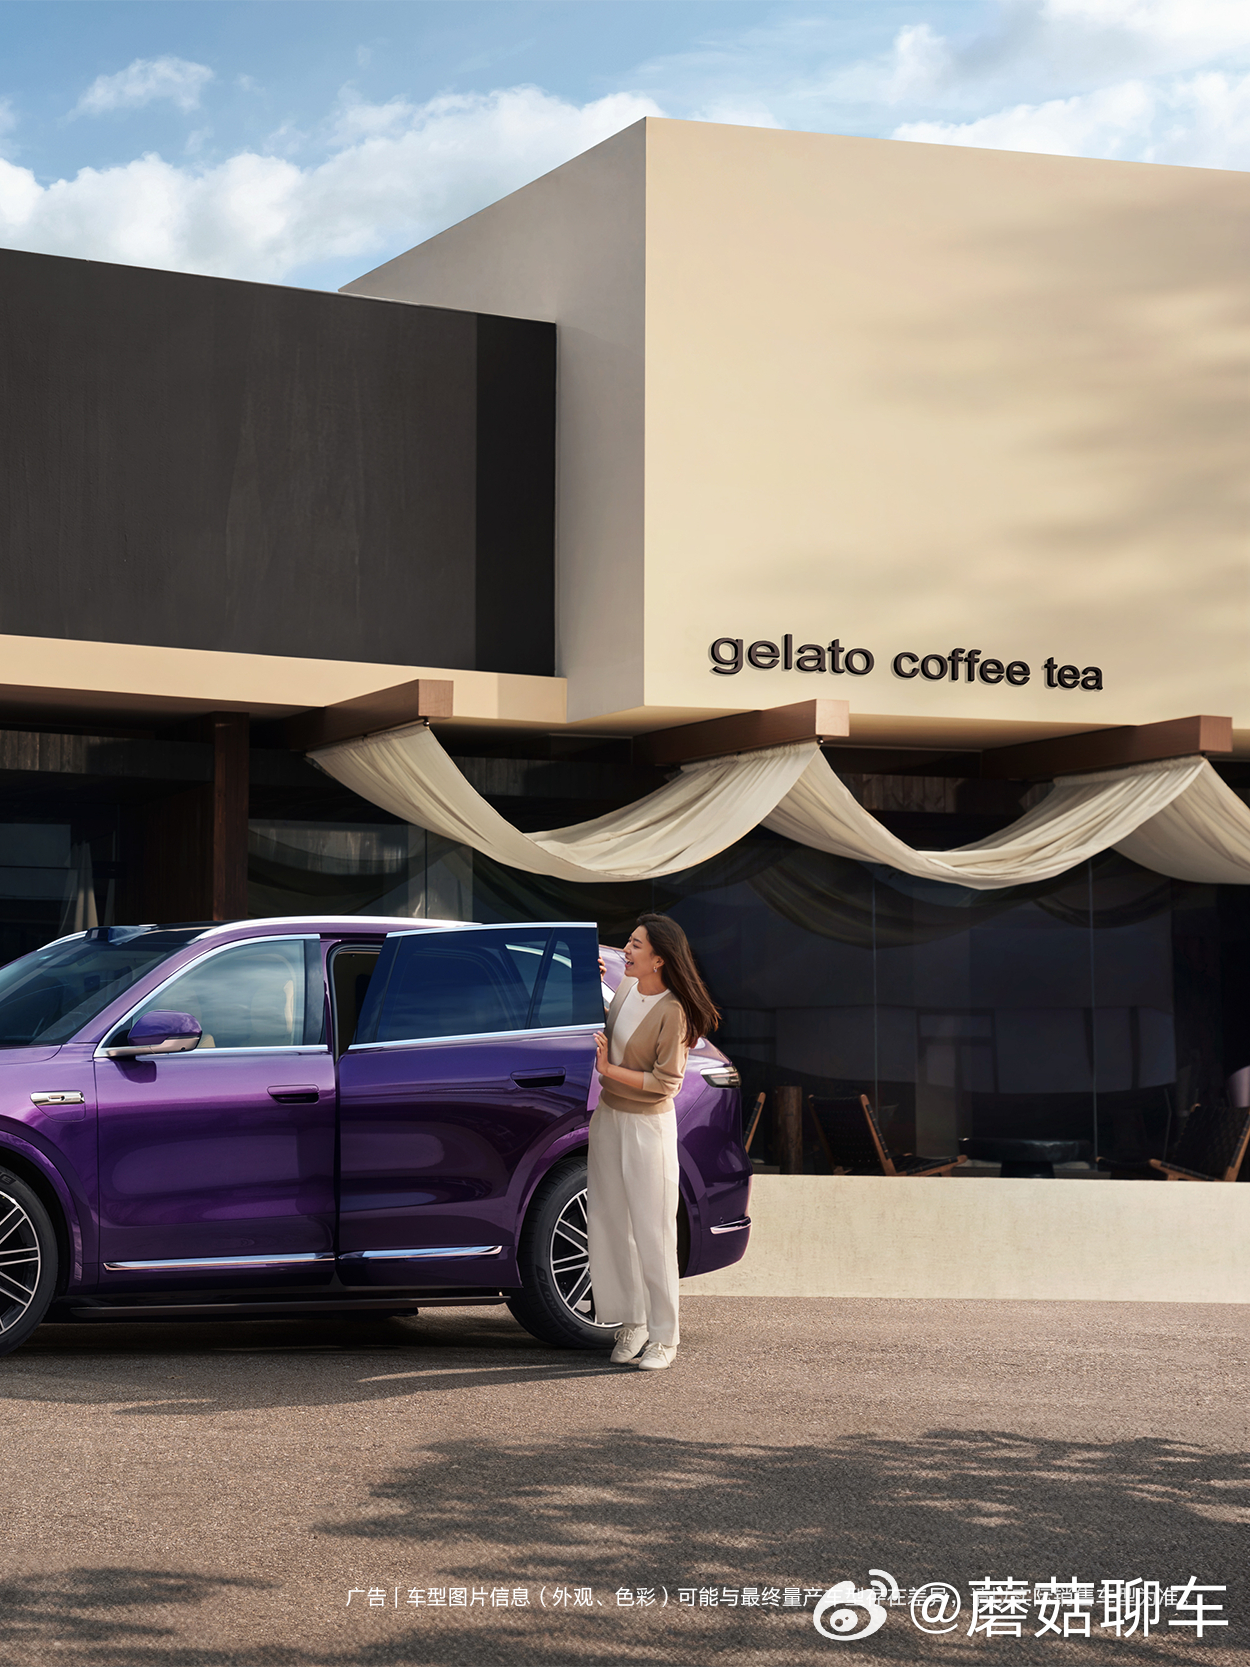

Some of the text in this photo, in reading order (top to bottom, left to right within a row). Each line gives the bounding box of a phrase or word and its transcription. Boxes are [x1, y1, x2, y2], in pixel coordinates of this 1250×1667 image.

[710, 633, 1104, 691] gelato coffee tea
